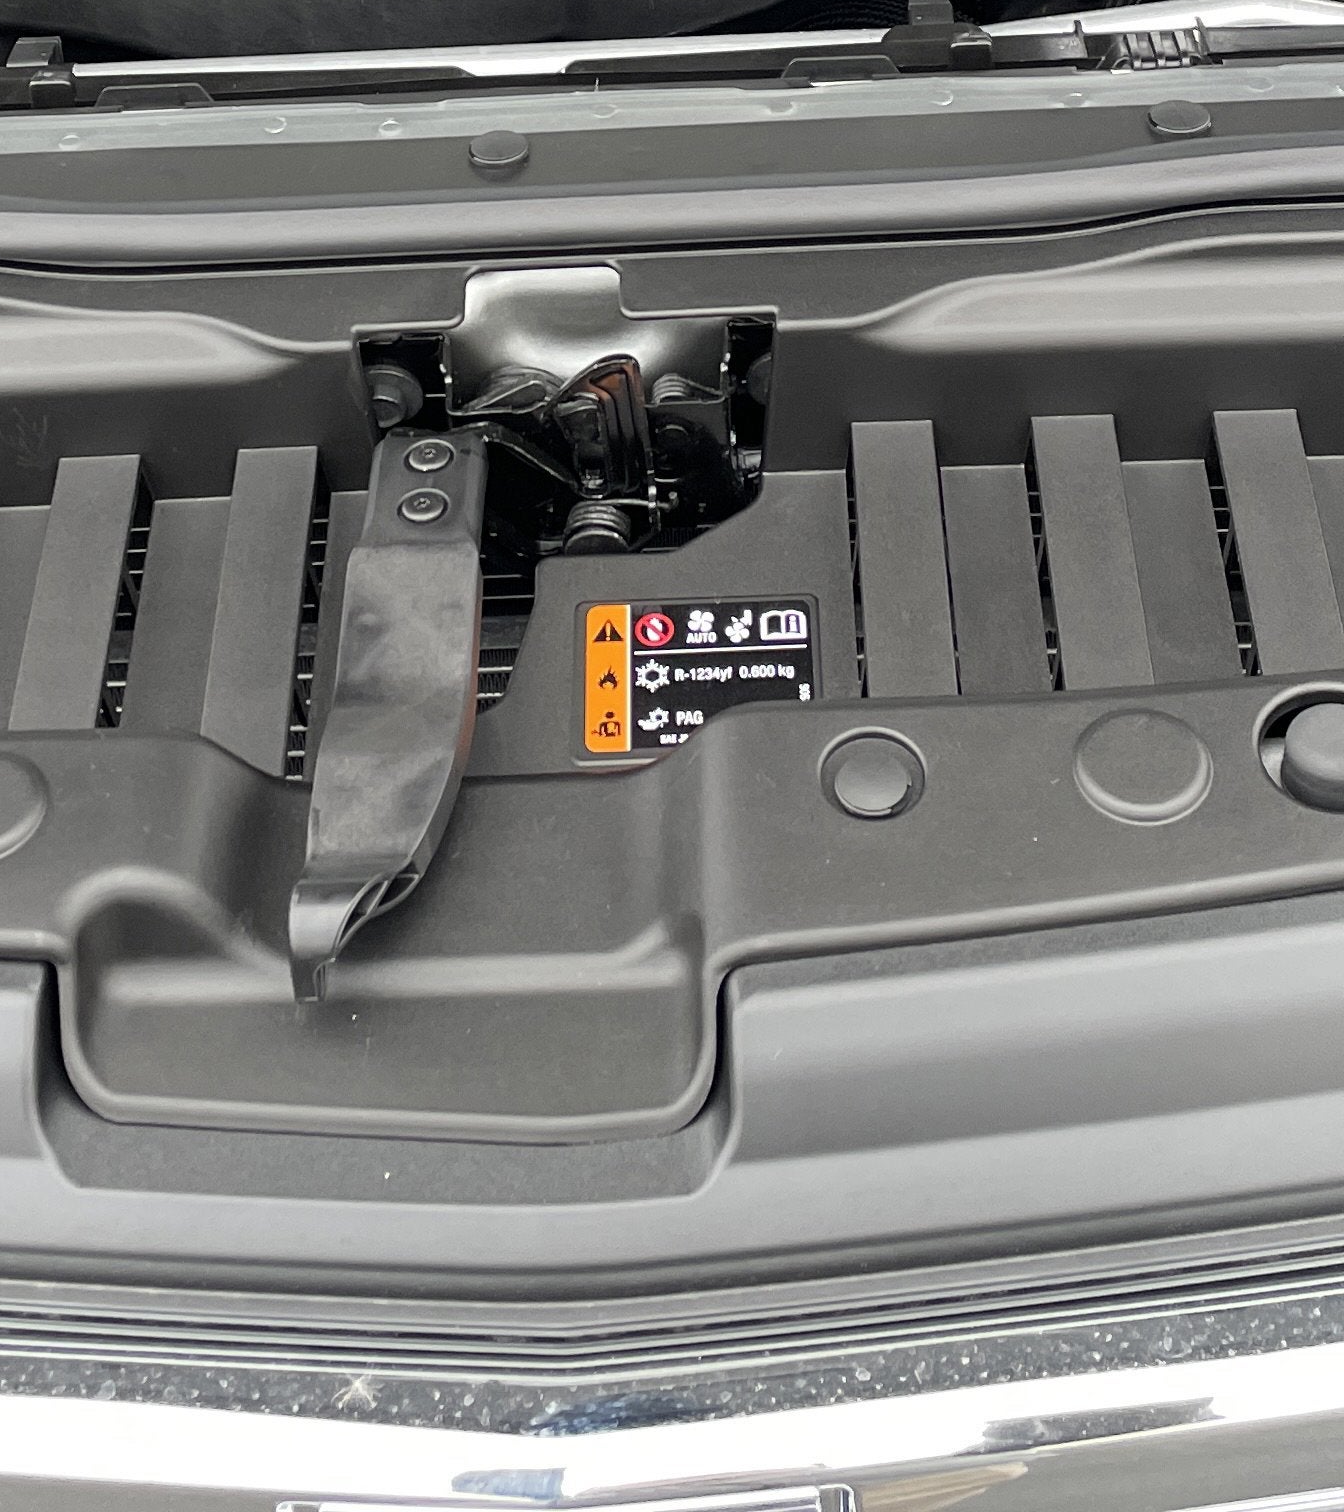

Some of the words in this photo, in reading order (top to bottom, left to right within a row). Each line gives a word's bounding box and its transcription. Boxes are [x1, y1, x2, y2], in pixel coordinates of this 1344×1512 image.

[686, 631, 717, 644] AUTO
[674, 666, 733, 683] R-1234yf
[738, 664, 776, 679] 0.600
[777, 663, 795, 679] kg
[675, 710, 704, 726] PAG
